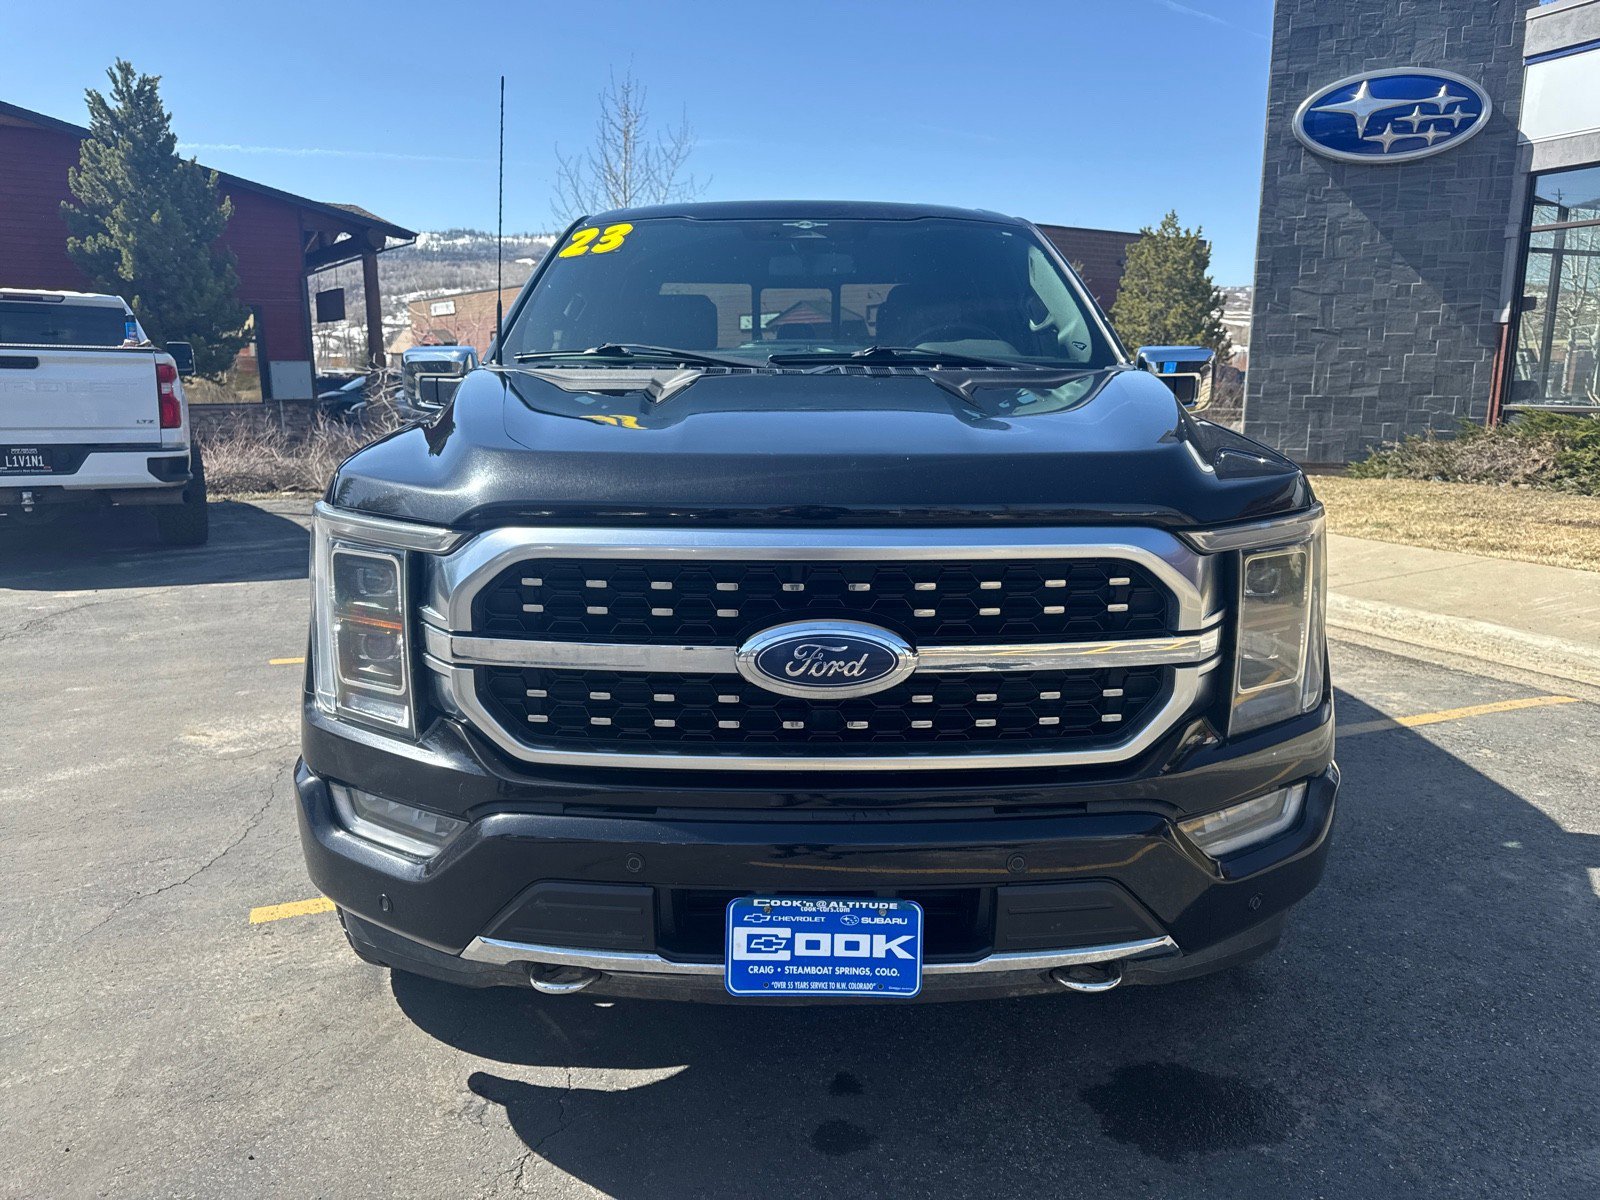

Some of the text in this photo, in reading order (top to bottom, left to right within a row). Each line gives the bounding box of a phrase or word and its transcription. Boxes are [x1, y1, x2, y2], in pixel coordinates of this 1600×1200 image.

[559, 223, 634, 258] 23
[5, 455, 45, 467] L1V1N1
[785, 643, 869, 677] Ford
[829, 901, 898, 910] ALTITUDE
[772, 915, 826, 923] CHEVROLET
[861, 917, 908, 925] SUBARU
[732, 926, 917, 961] COOK
[748, 965, 901, 977] CRAIG STEAMBOAT SPRINGS, COLO.
[787, 981, 794, 990] 55
[794, 982, 809, 990] YEARS
[809, 982, 829, 990] SERVICE
[829, 982, 836, 990] TO
[836, 982, 848, 990] N.W.
